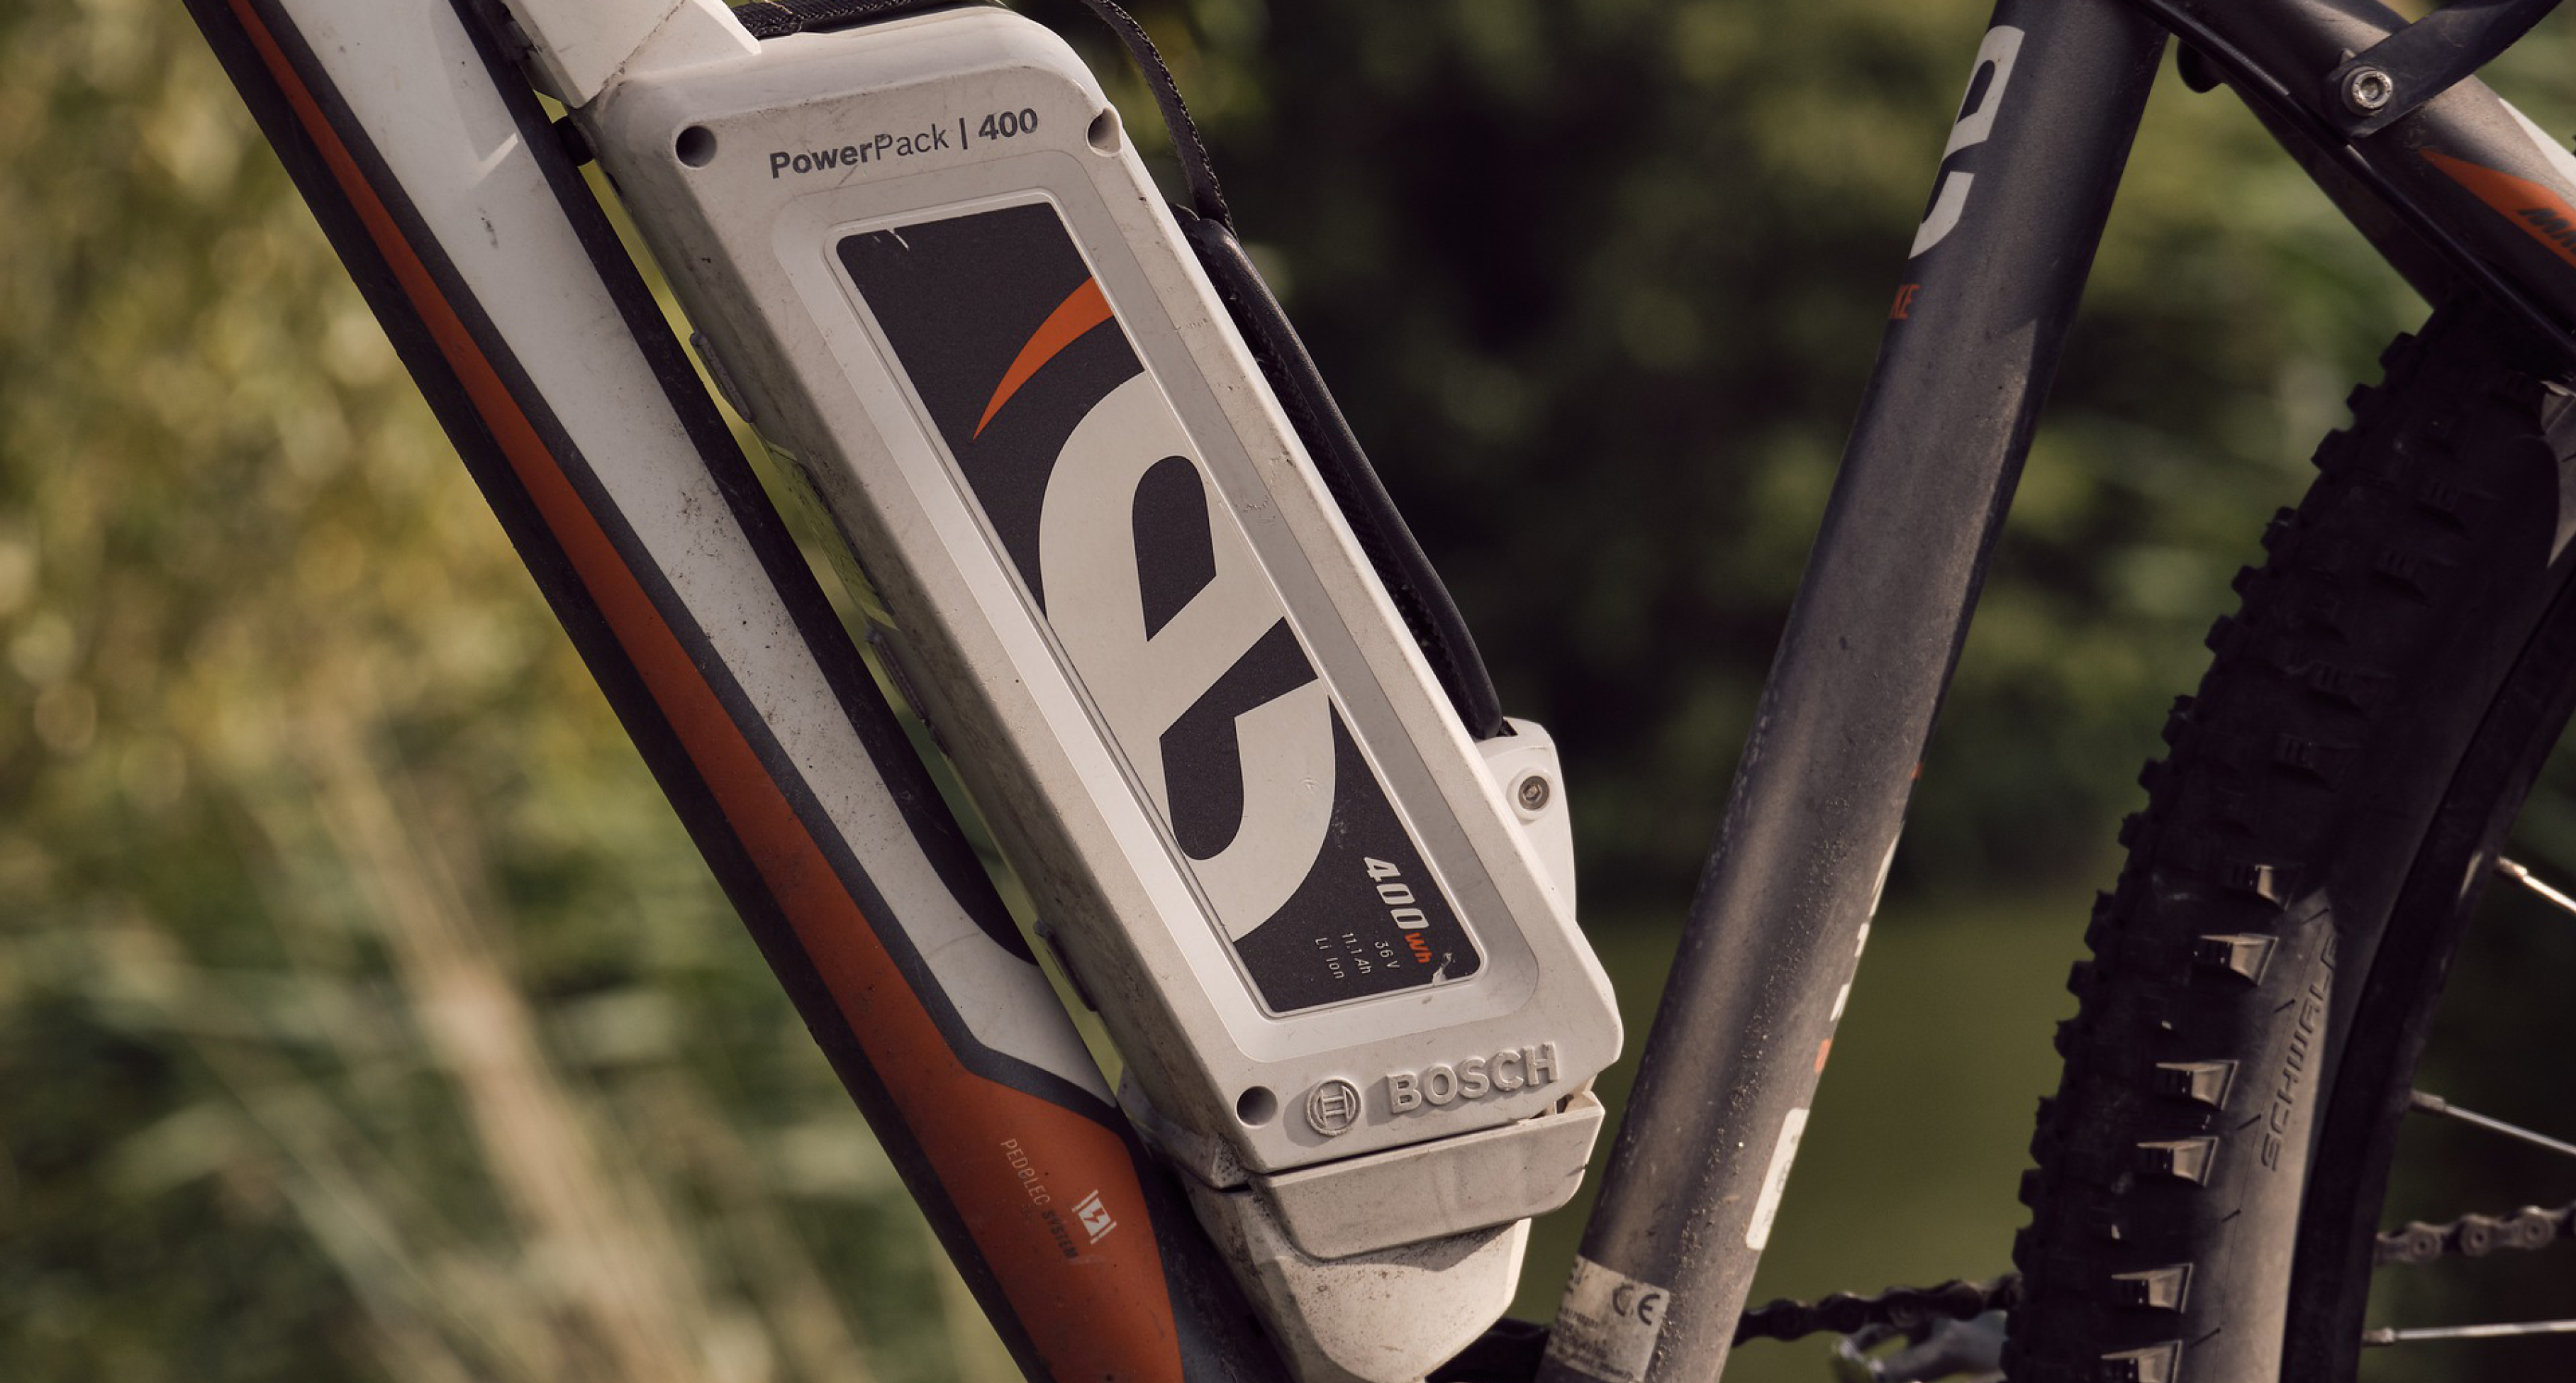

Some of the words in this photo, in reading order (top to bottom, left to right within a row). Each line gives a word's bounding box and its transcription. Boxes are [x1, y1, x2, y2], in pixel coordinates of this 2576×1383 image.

[770, 124, 949, 179] PowerPack
[978, 108, 1039, 142] 400
[1315, 937, 1332, 950] Li
[1326, 957, 1345, 979] Ion
[1342, 932, 1364, 955] 11.1
[1355, 957, 1373, 974] Ah
[1375, 940, 1394, 958] 36
[1387, 960, 1400, 969] V
[1387, 1041, 1560, 1115] BOSCH
